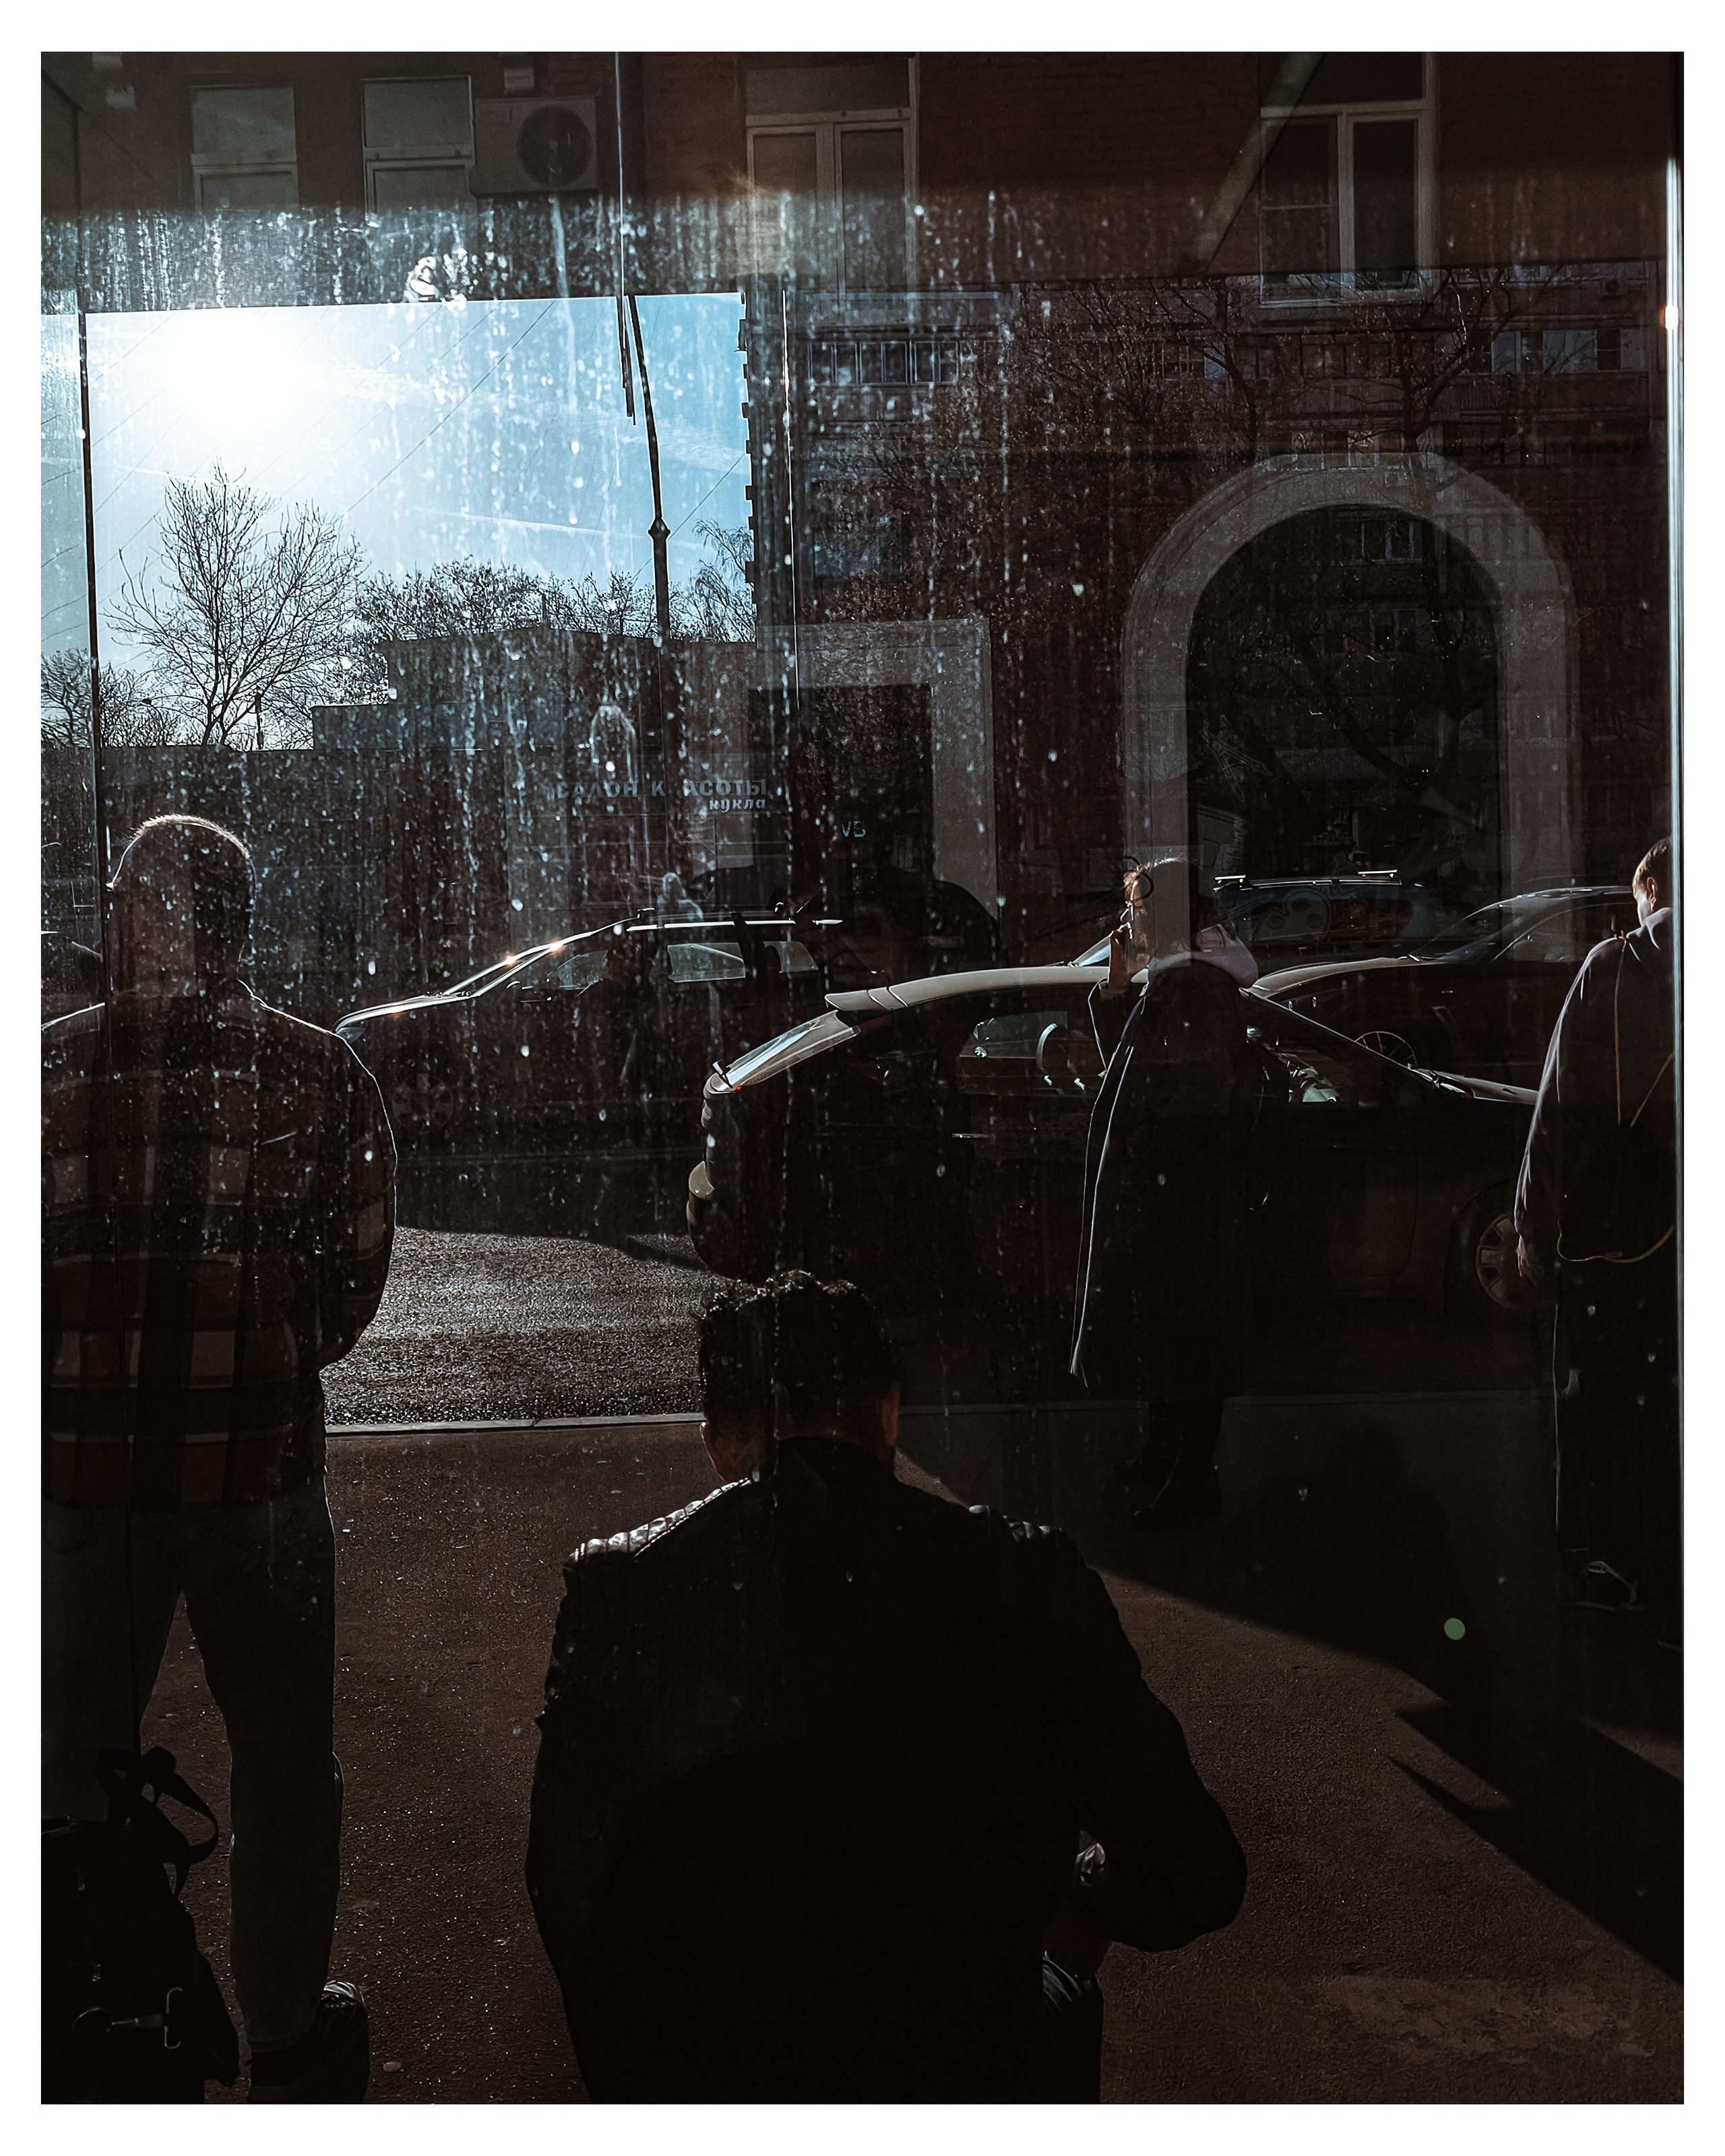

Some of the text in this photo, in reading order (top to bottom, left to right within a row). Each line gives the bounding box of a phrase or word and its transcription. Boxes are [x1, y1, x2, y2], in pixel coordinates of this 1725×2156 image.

[556, 780, 766, 798] САЛОН КАСОТЫ
[710, 798, 766, 813] кукла
